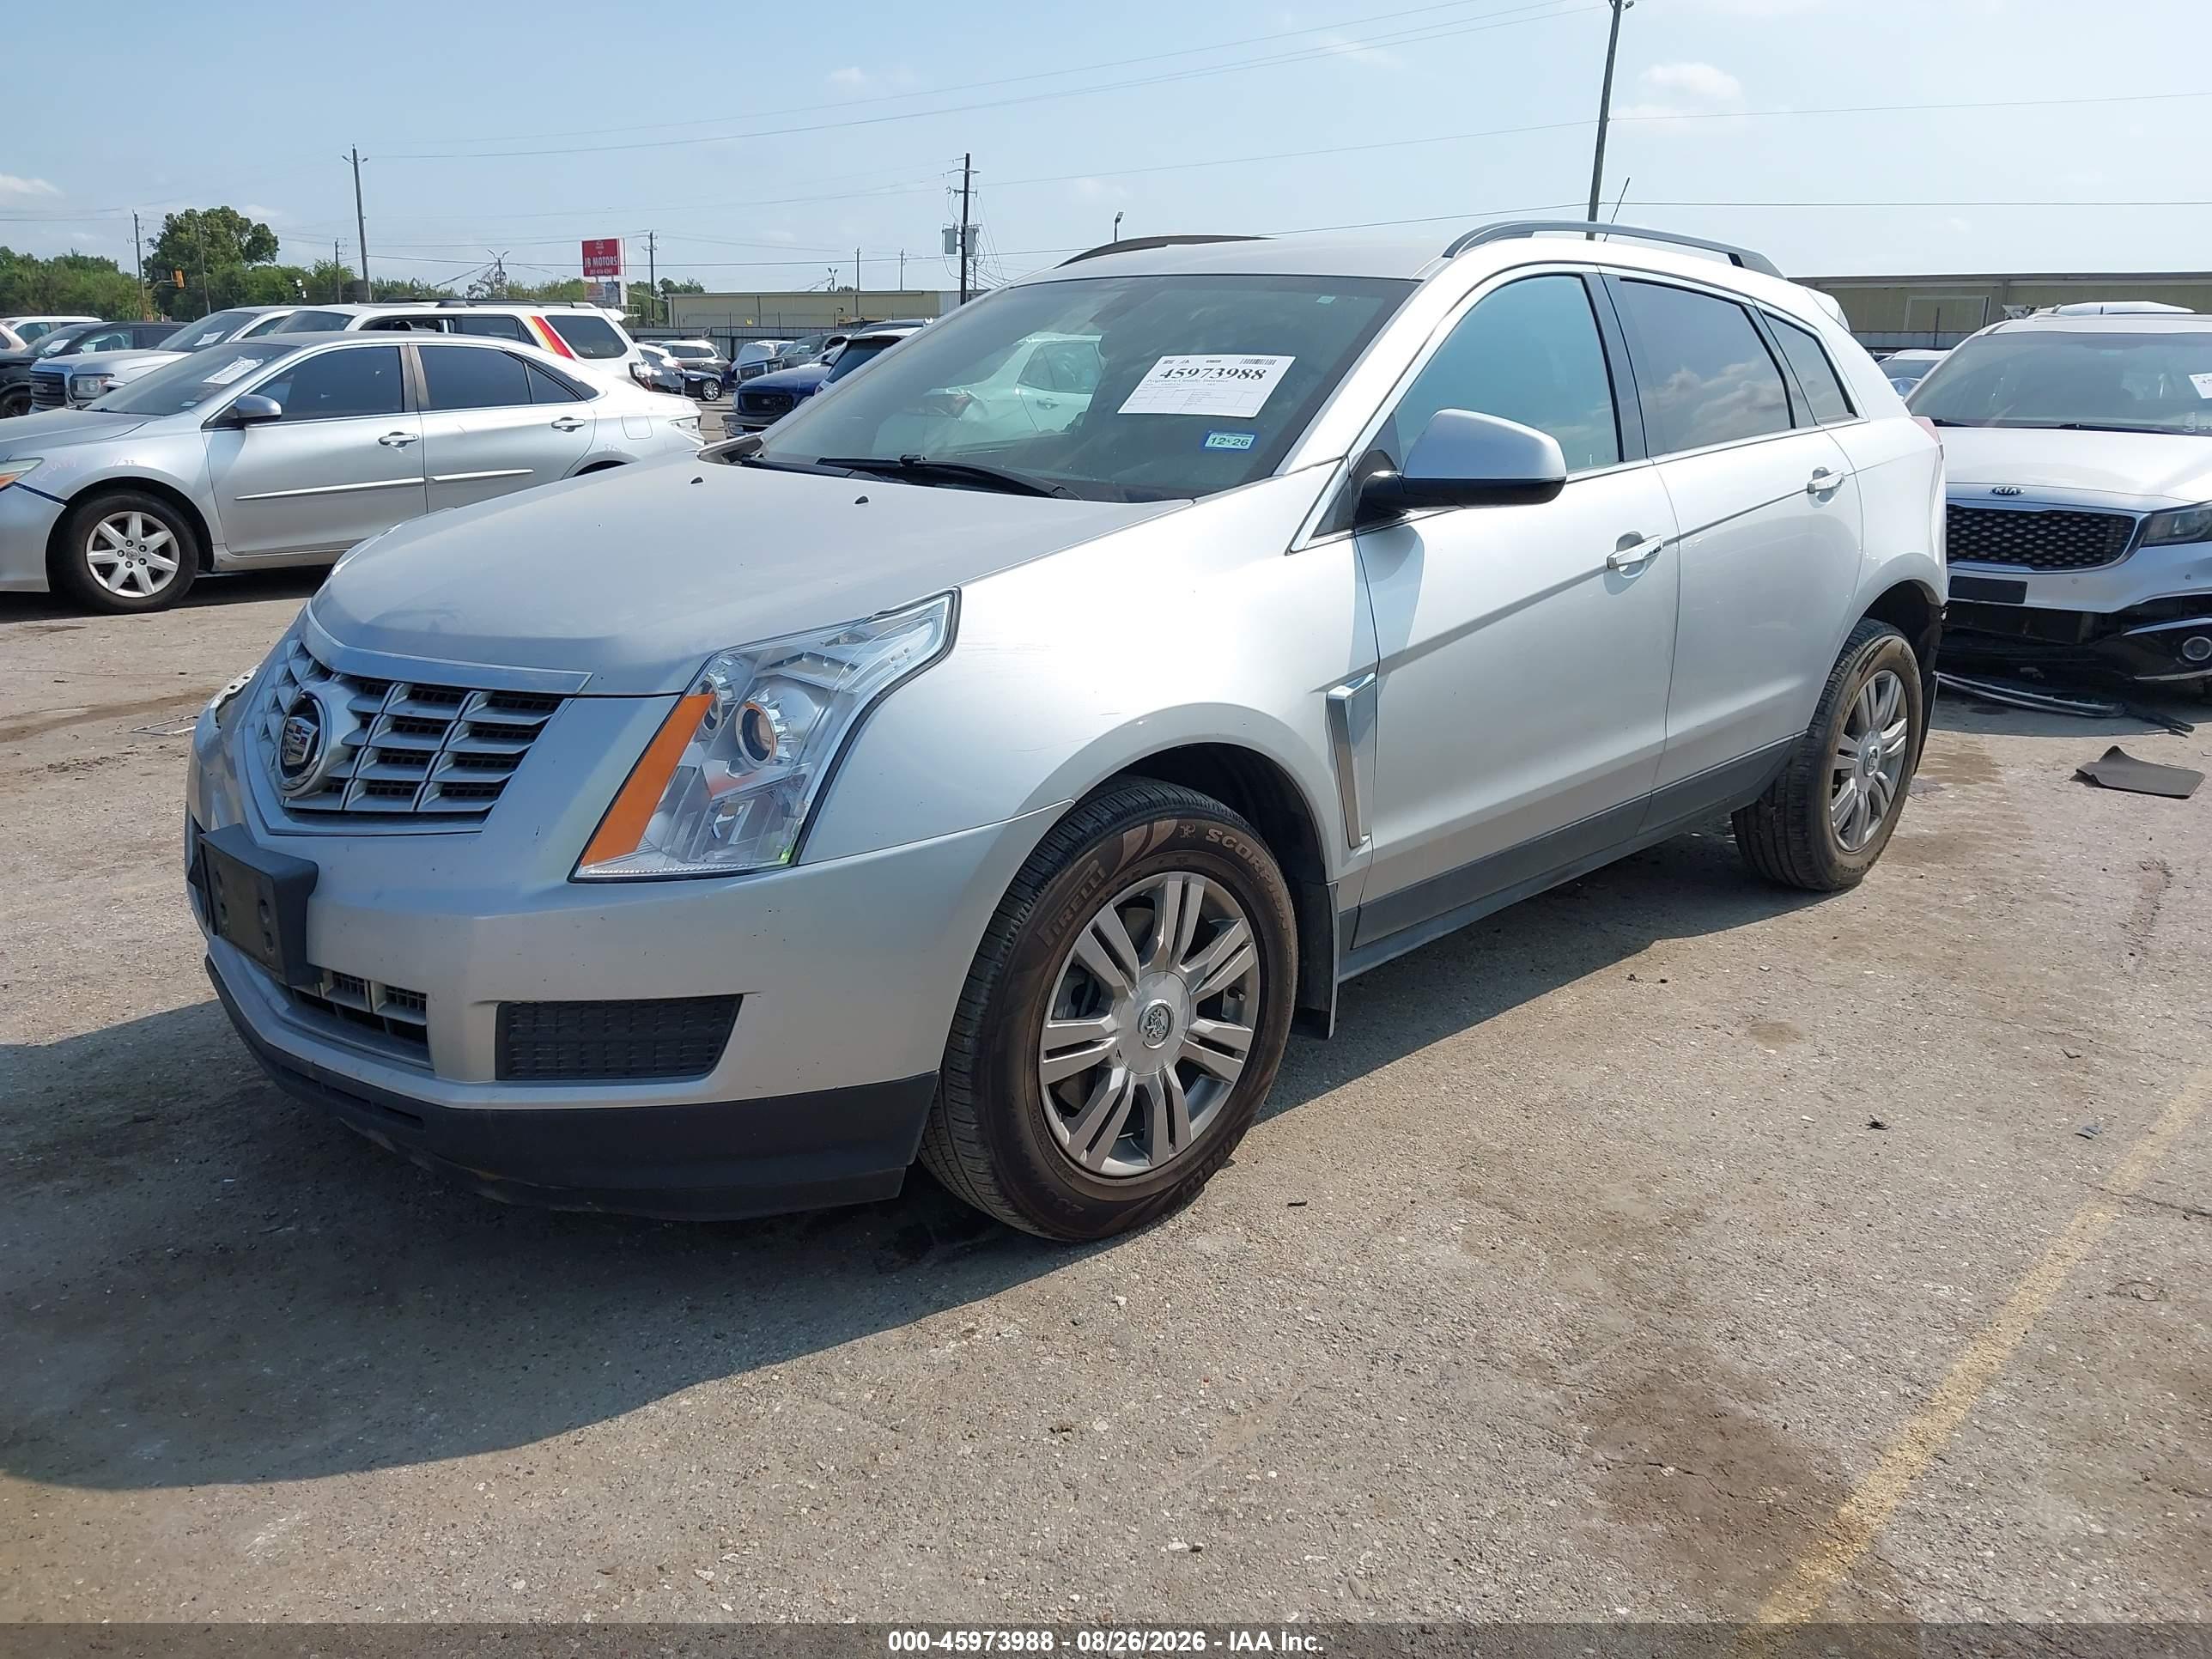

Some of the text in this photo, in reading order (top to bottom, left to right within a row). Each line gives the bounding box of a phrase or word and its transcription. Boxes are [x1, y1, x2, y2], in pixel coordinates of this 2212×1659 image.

[592, 255, 618, 267] MOTORS
[1159, 368, 1267, 380] 45973988
[1211, 437, 1249, 447] 12 26
[1036, 860, 1107, 947] PIRELLI
